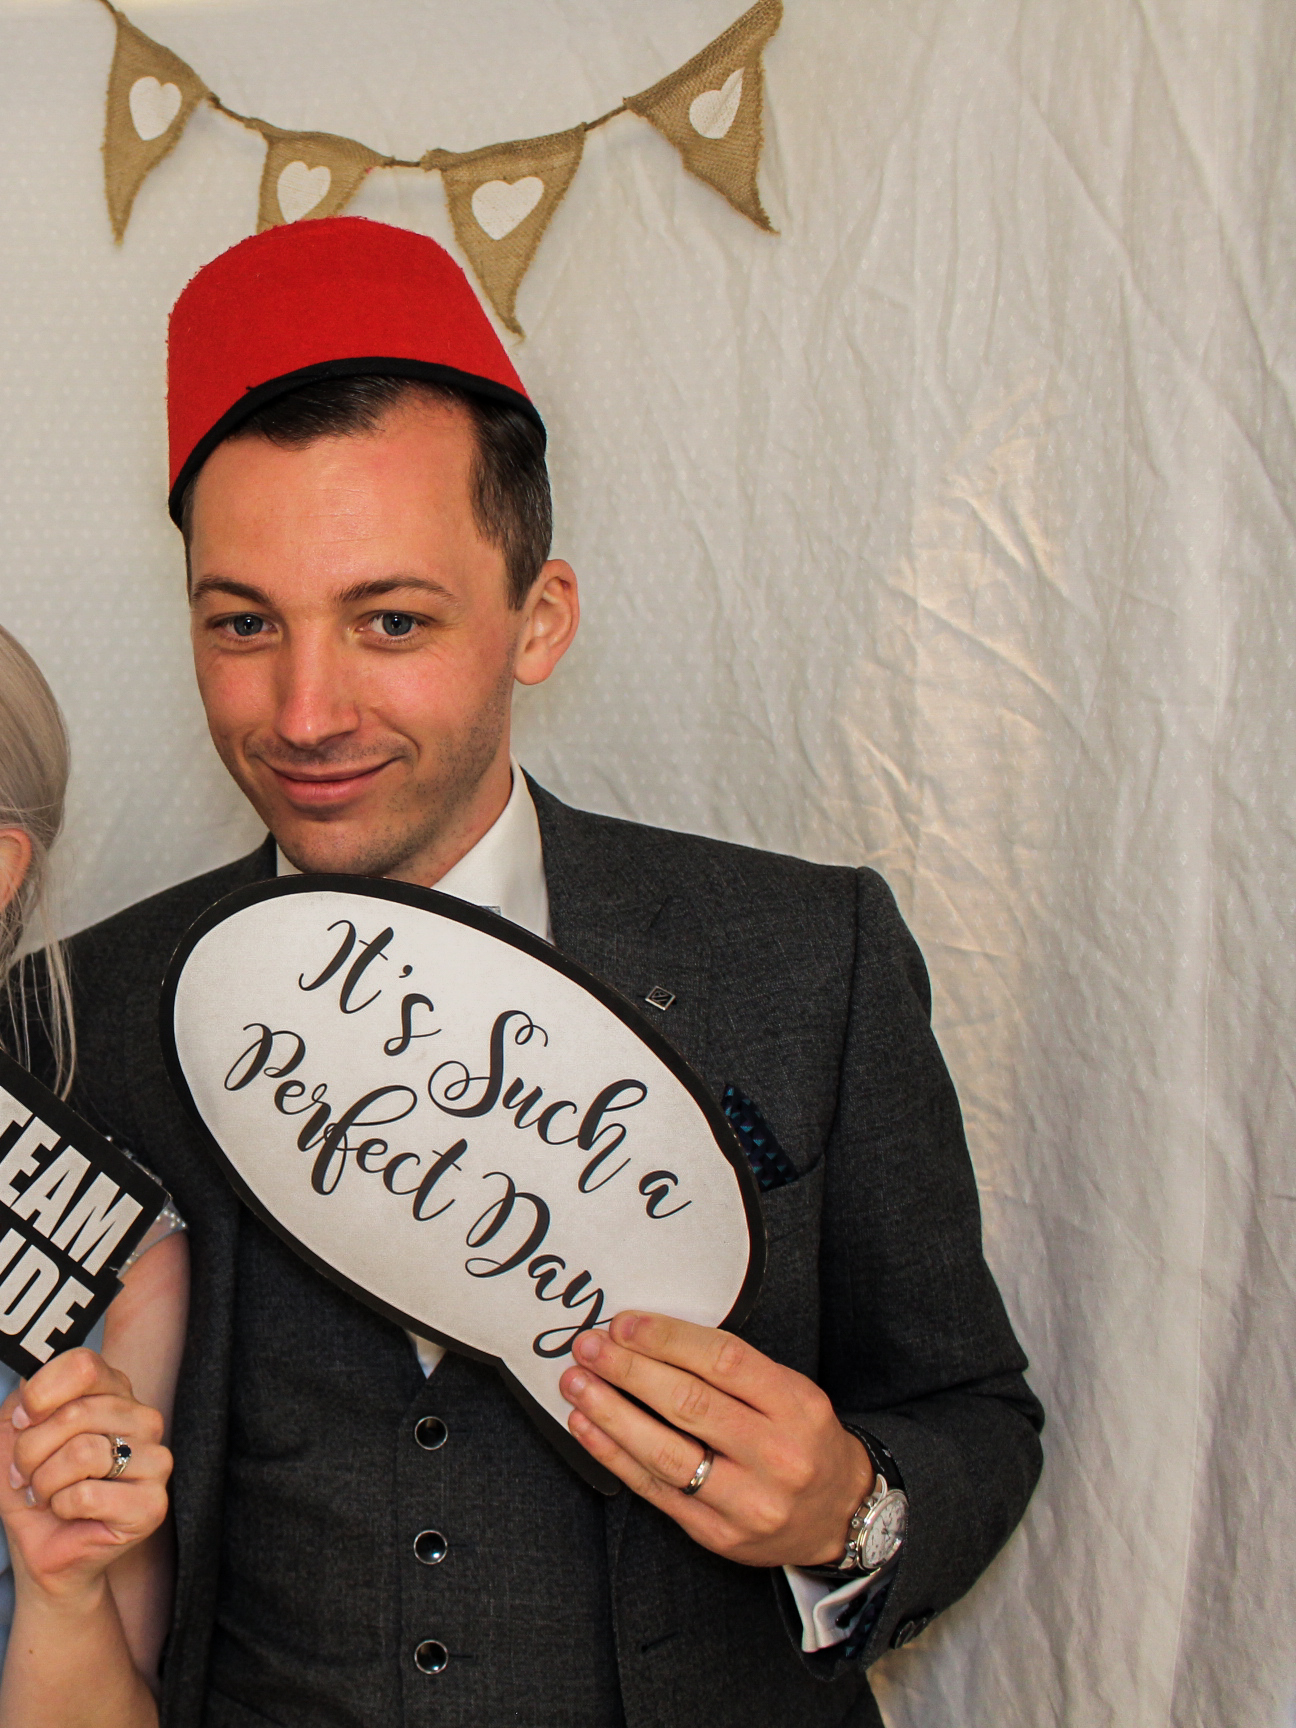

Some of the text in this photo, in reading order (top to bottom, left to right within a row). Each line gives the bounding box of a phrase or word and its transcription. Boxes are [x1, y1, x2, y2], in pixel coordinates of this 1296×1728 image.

[224, 1022, 615, 1359] Perfect Day
[298, 919, 692, 1219] It's Such a
